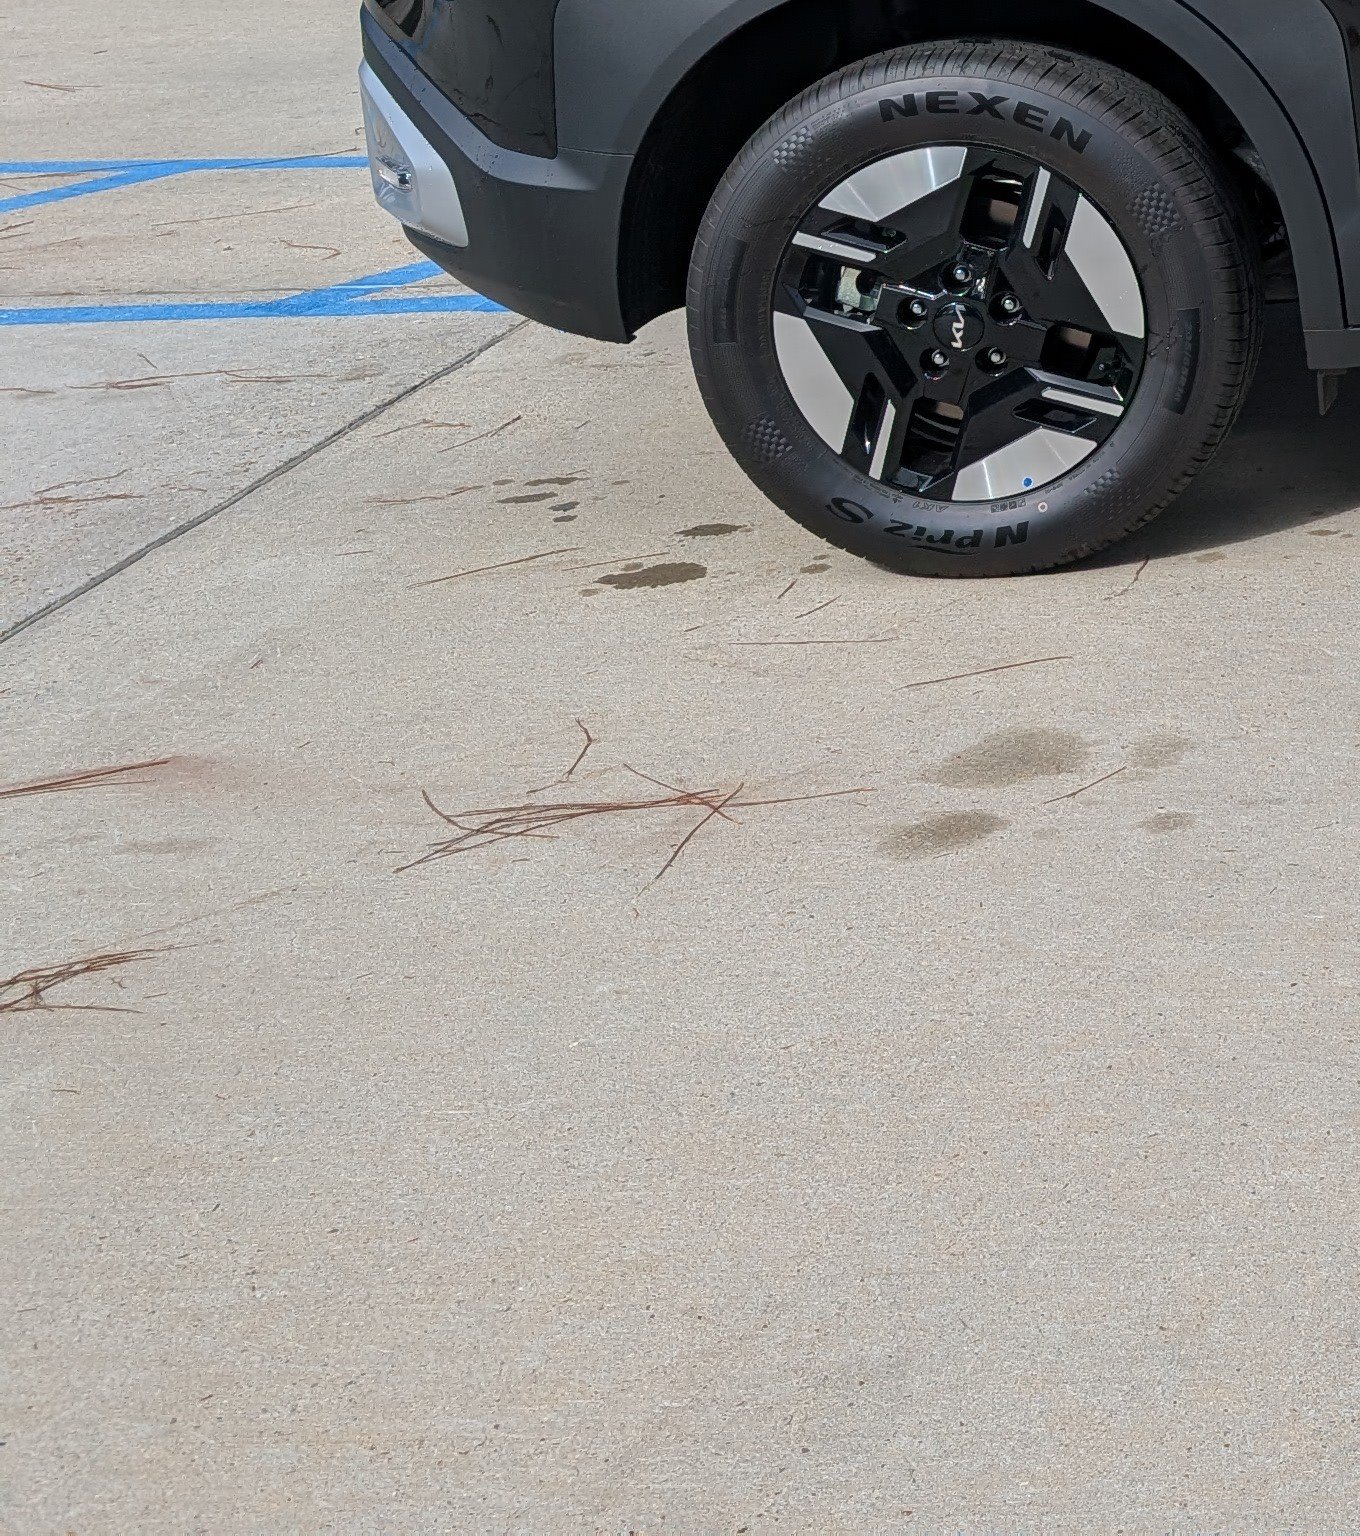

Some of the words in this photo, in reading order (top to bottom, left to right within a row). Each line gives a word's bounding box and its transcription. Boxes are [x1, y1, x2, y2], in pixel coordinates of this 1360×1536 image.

[878, 90, 1093, 155] NEXEN
[824, 497, 875, 524] S
[993, 520, 1029, 548] N
